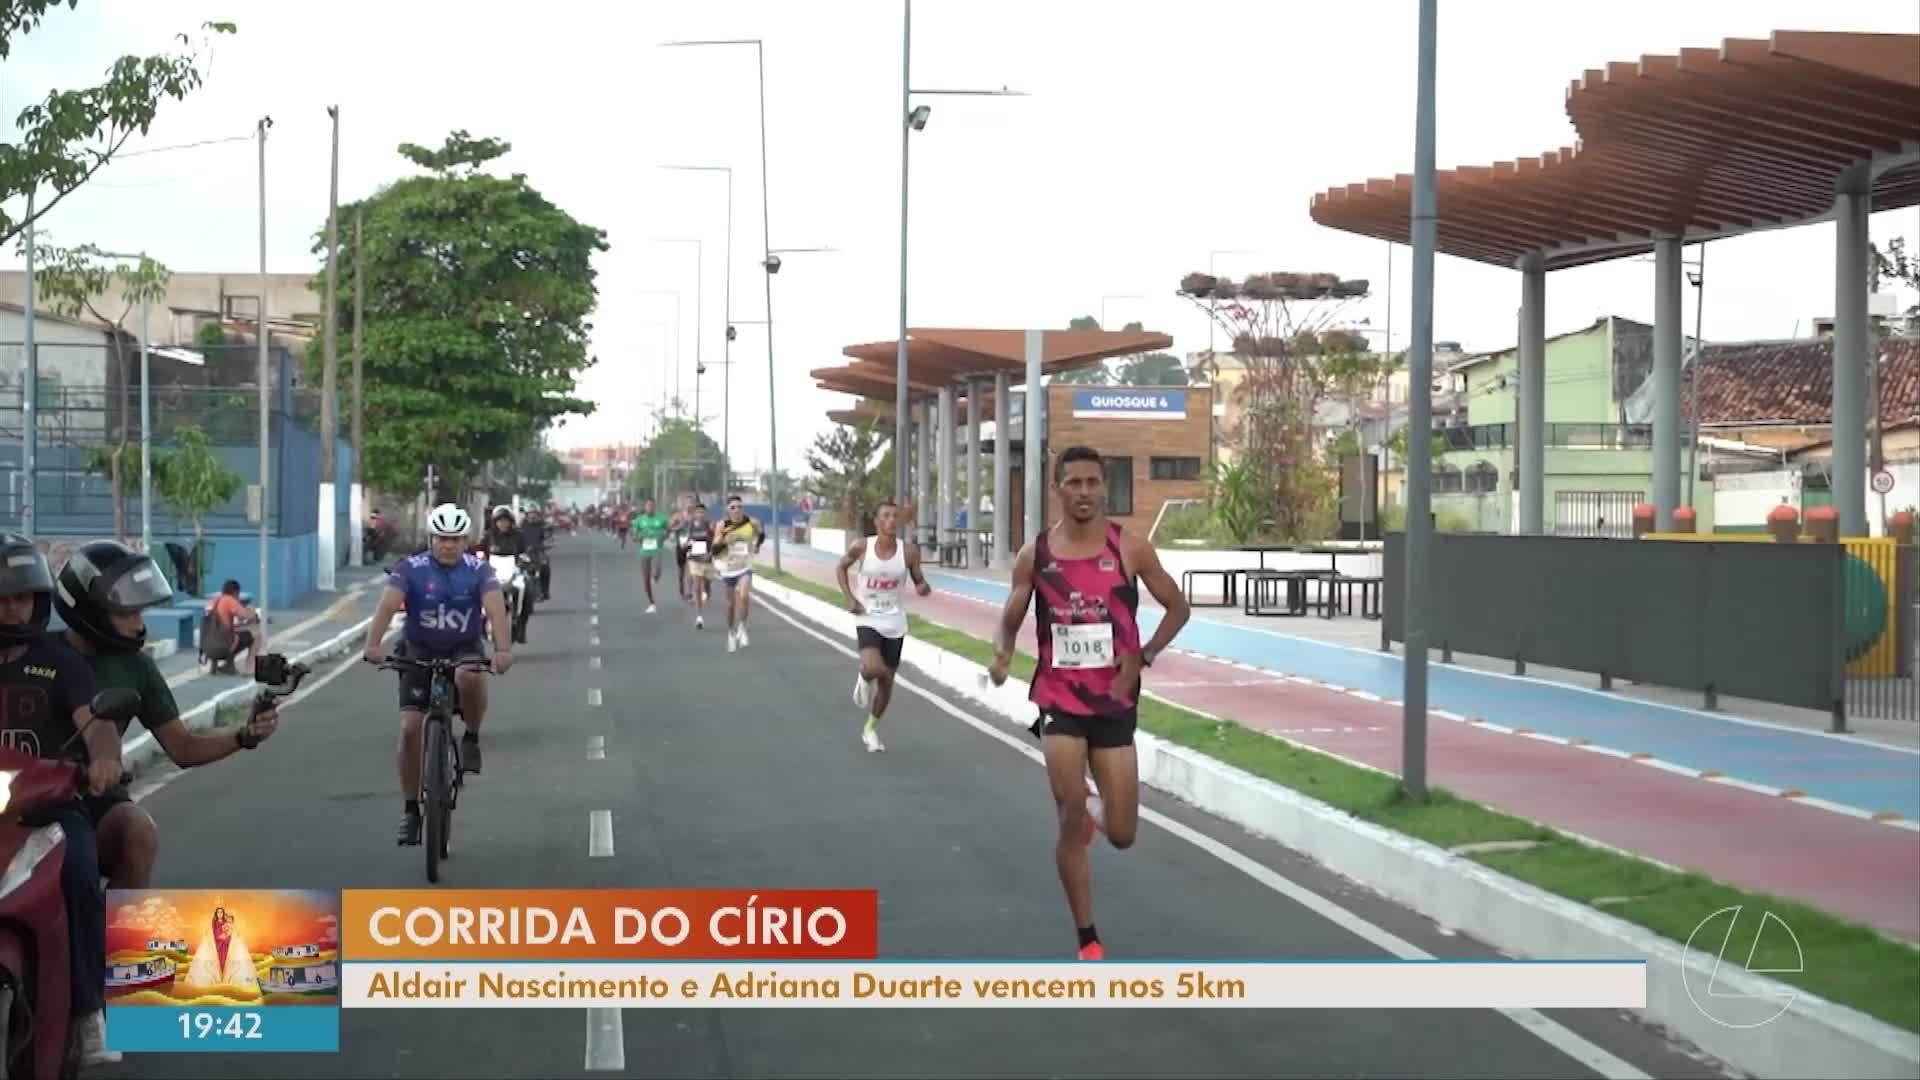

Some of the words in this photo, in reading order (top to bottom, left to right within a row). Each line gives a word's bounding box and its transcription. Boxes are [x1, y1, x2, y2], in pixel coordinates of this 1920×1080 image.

[1090, 395, 1157, 410] QUIOSQUE
[1159, 396, 1169, 409] 4
[419, 603, 473, 633] sky
[1063, 641, 1103, 654] 1018
